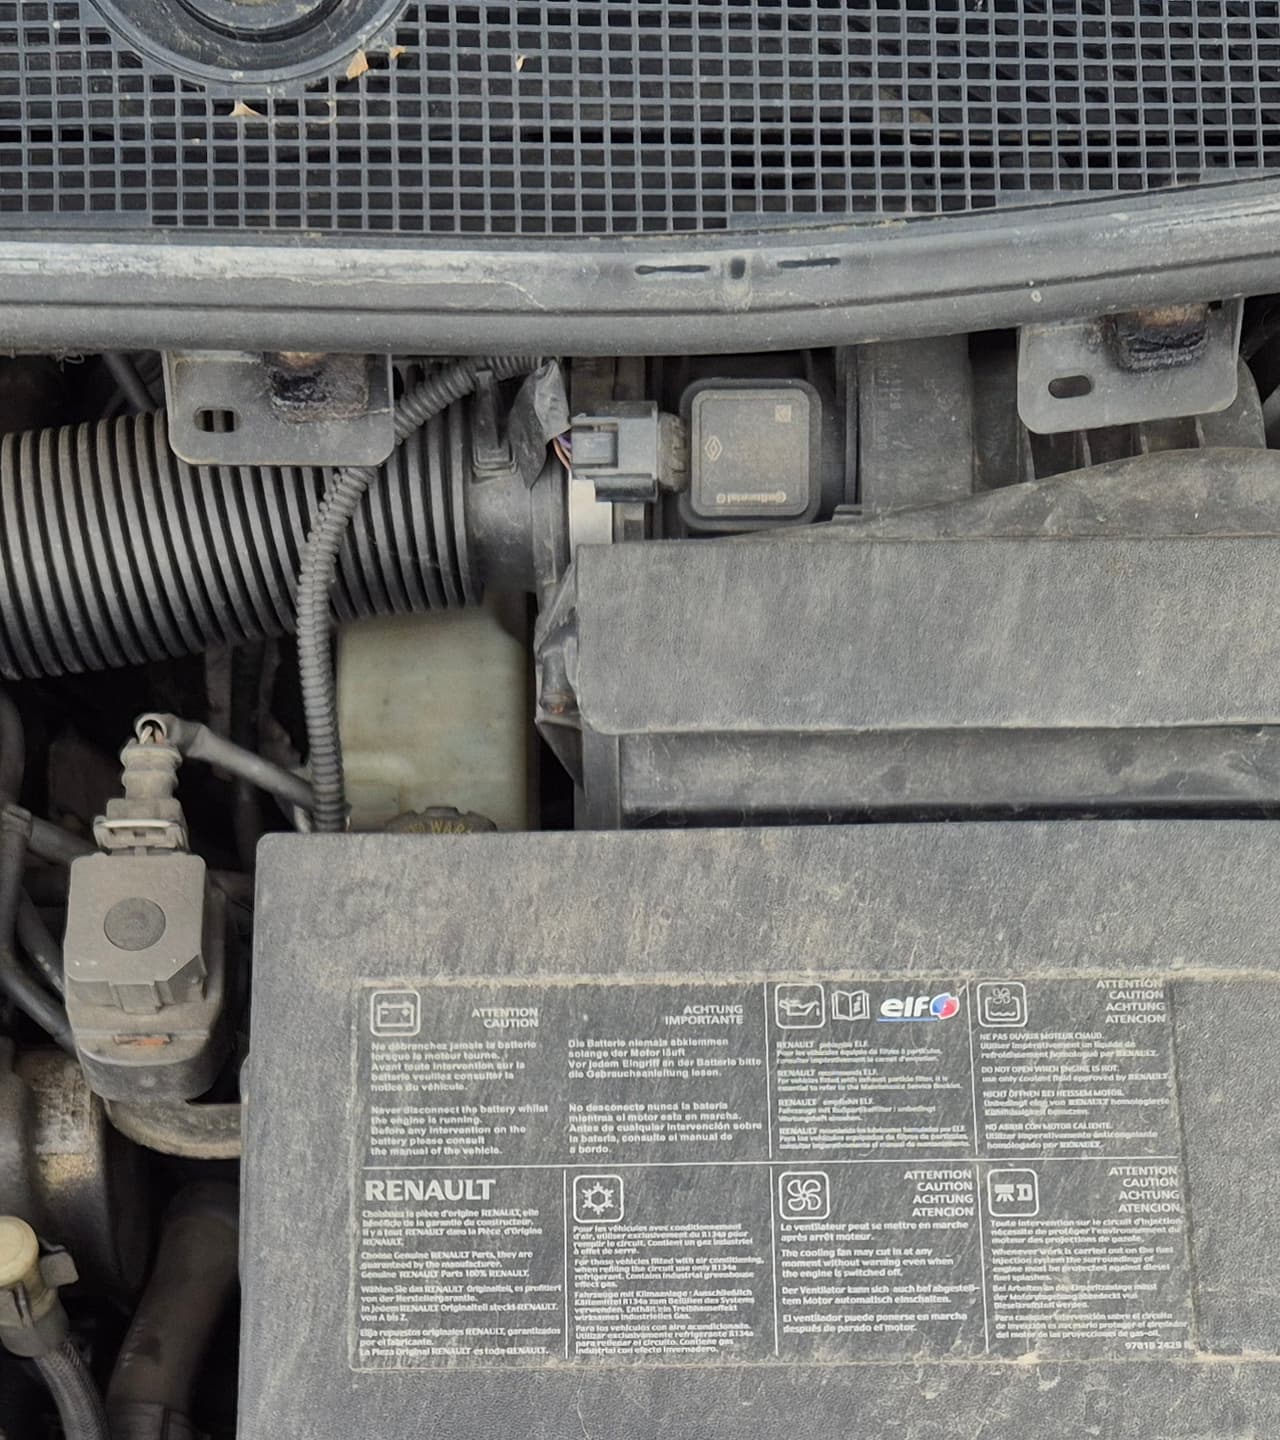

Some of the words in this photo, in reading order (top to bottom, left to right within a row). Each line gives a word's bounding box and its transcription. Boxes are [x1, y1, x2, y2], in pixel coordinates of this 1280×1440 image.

[1096, 979, 1162, 988] ATTENTION
[1109, 991, 1163, 999] CAUTION
[683, 1005, 743, 1014] ACHTUNG
[881, 996, 929, 1017] elf
[1105, 1002, 1165, 1011] ACHTUNG
[472, 1008, 538, 1017] ATTENTION
[665, 1016, 743, 1025] IMPORTANTE
[1105, 1014, 1166, 1023] ATENCION
[484, 1019, 539, 1028] CAUTION
[904, 1170, 972, 1179] ATTENTION
[1109, 1167, 1177, 1176] ATTENTION
[917, 1182, 972, 1191] CAUTION
[1123, 1178, 1178, 1188] CAUTION
[365, 1179, 496, 1201] RENAULT
[913, 1195, 974, 1204] ACHTUNG
[1119, 1190, 1179, 1200] ACHTUNG
[912, 1207, 974, 1216] ATENCION
[1119, 1203, 1181, 1213] ATENCION
